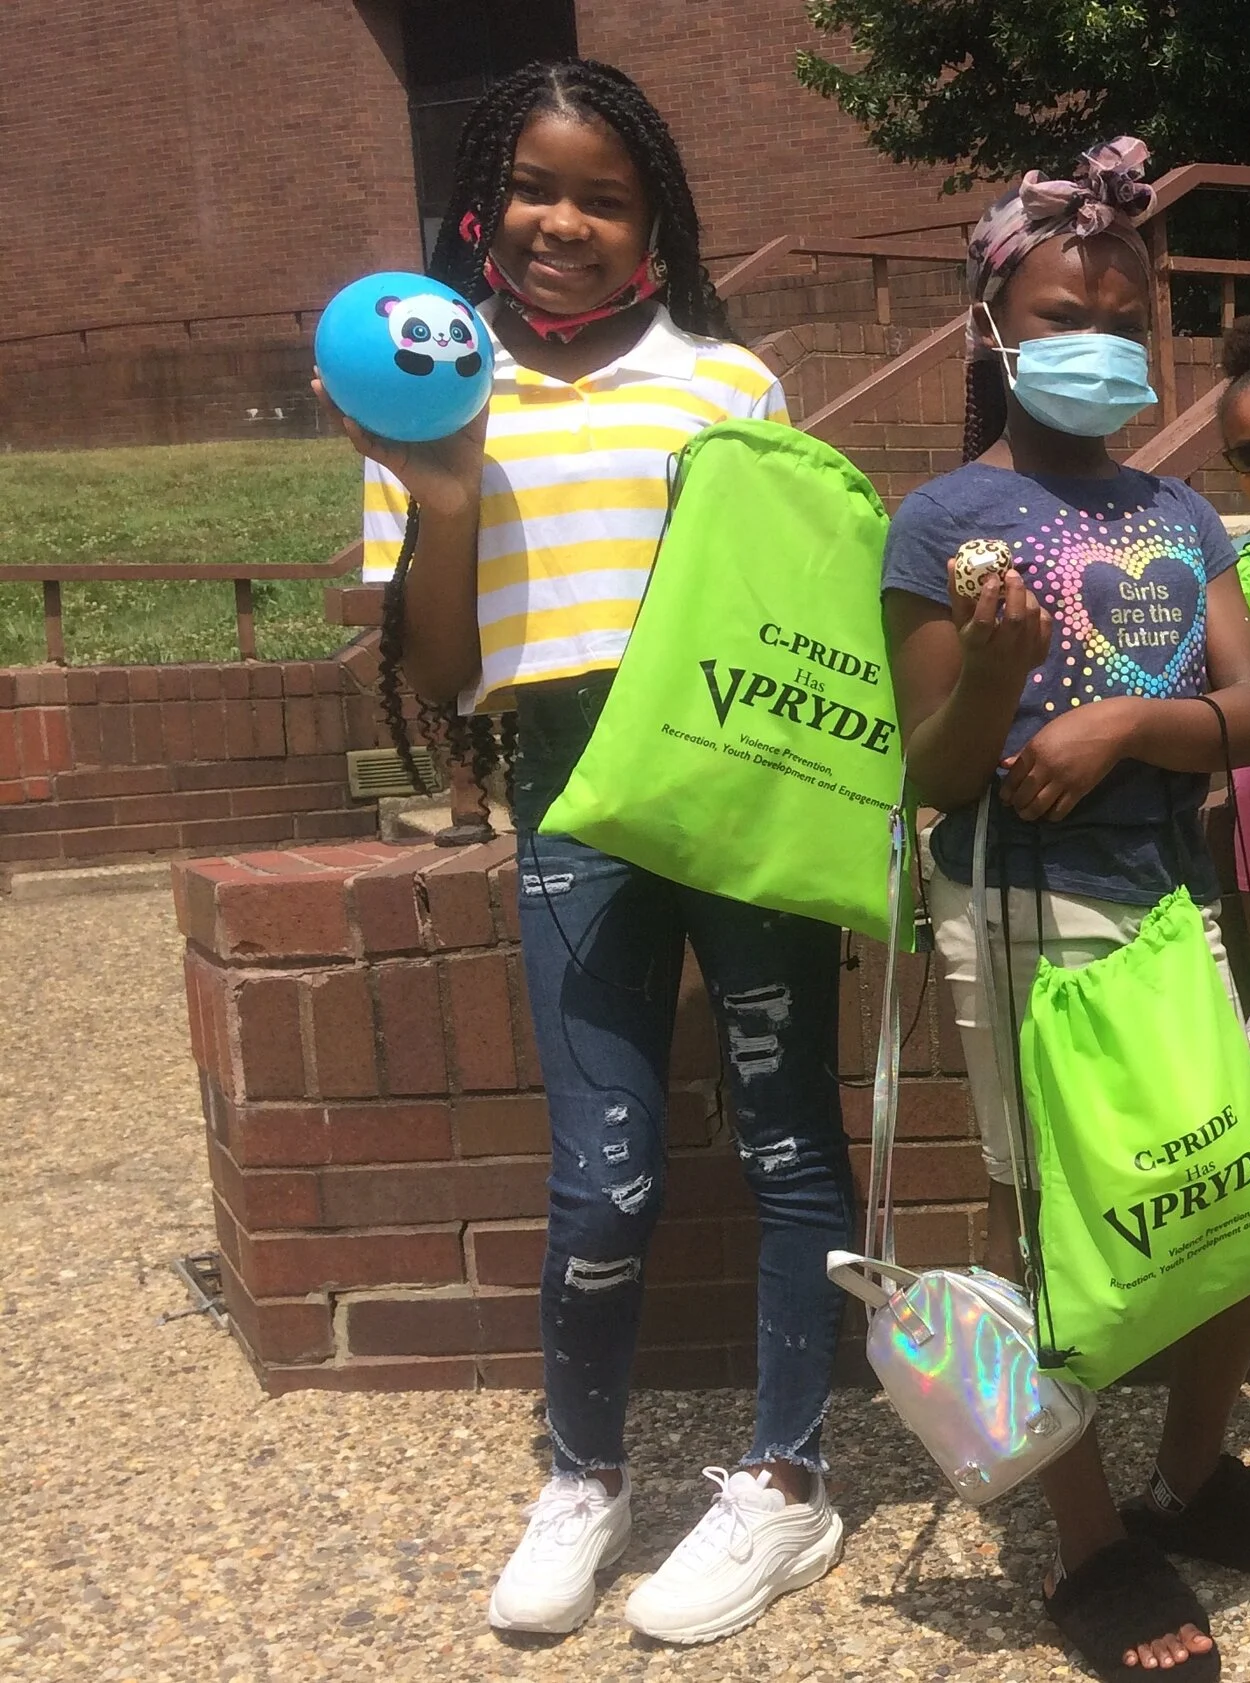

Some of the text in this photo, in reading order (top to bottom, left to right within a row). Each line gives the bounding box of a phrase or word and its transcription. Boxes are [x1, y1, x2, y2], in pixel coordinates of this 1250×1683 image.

[1119, 582, 1170, 601] Girls
[1111, 603, 1182, 624] are the
[759, 622, 881, 686] C-PRIDE
[1117, 627, 1180, 649] future
[793, 667, 826, 693] Has
[699, 658, 897, 755] VPRYDE
[661, 723, 718, 752] Recreation,
[722, 743, 751, 761] Youth
[752, 754, 816, 785] Development
[817, 780, 838, 792] and
[740, 733, 833, 777] Violence Prevention,
[1134, 1104, 1239, 1172] C-PRIDE
[1185, 1160, 1217, 1183] Has
[1159, 1256, 1185, 1275] Youth
[1186, 1226, 1241, 1260] Development
[1168, 1234, 1204, 1257] Violence
